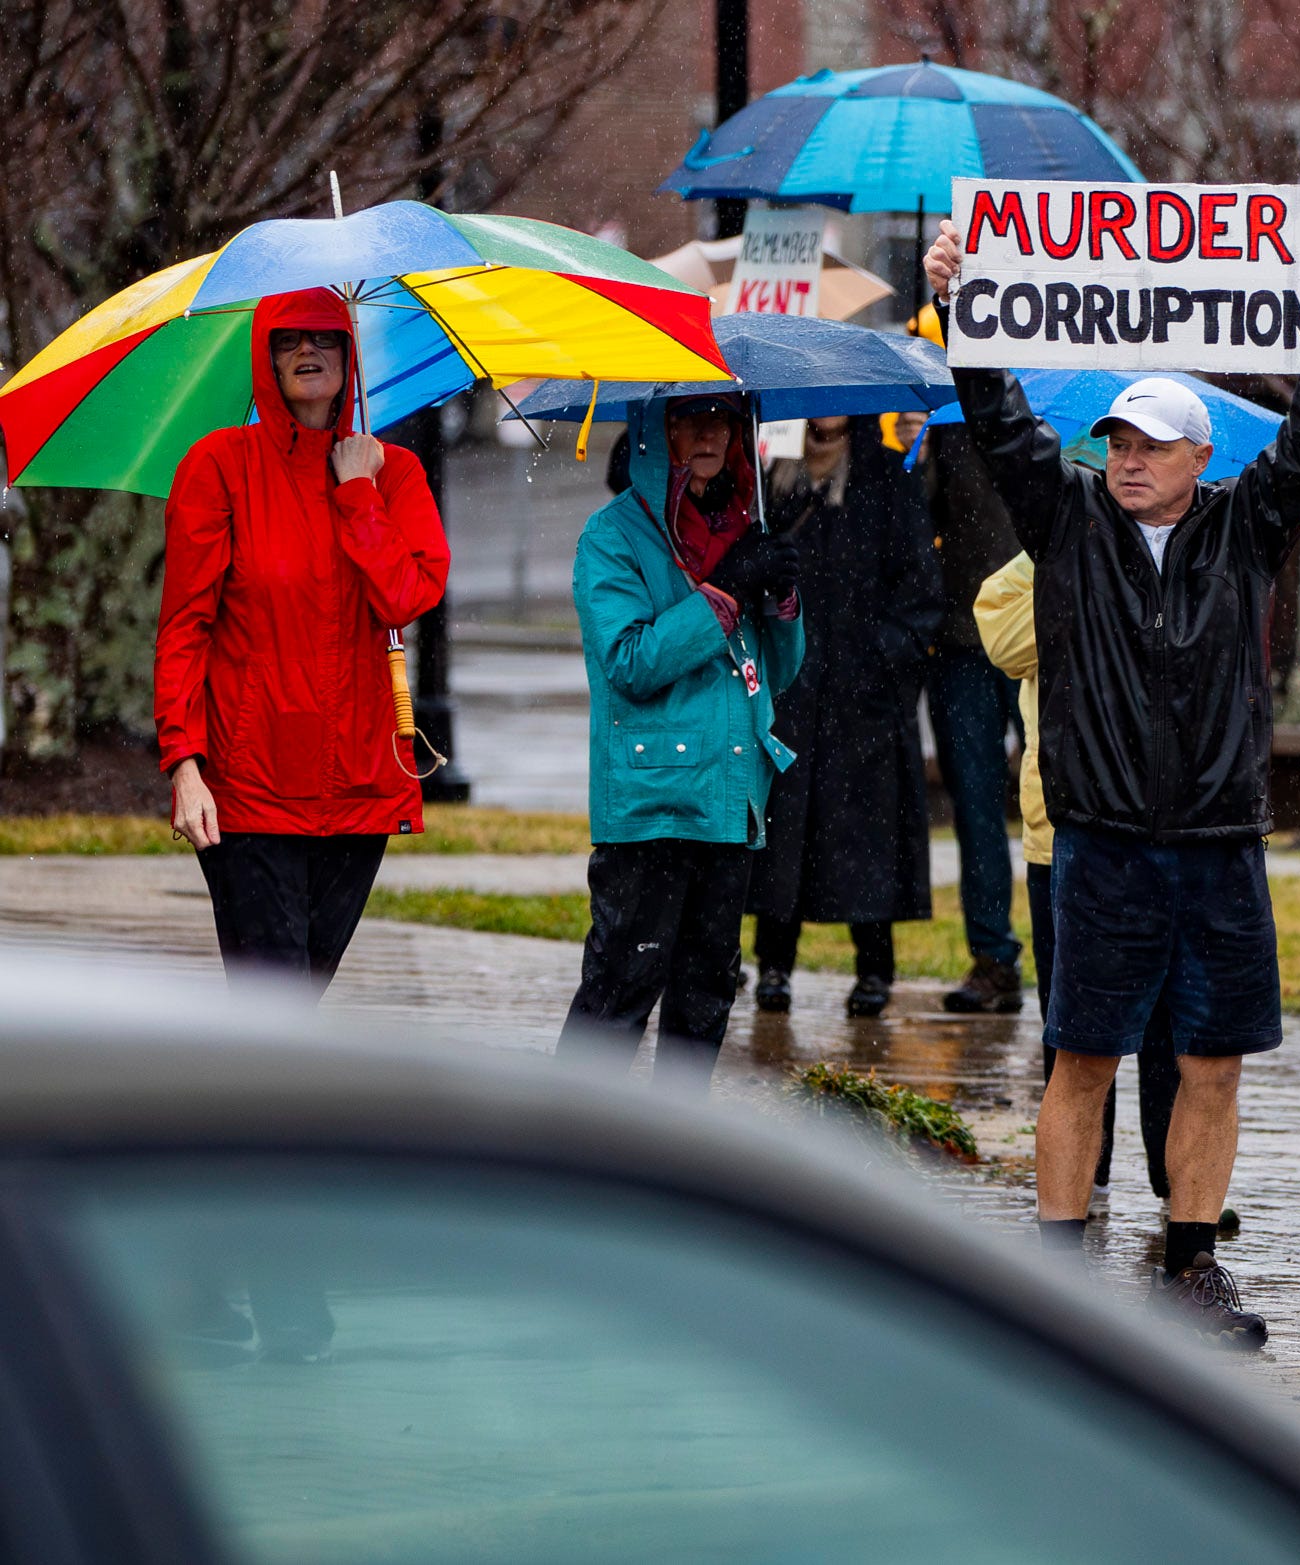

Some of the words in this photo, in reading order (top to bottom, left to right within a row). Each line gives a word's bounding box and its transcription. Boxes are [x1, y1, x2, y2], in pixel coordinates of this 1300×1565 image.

[965, 190, 1296, 265] MURDER
[742, 231, 819, 264] REMEMBER
[736, 279, 810, 316] KENT
